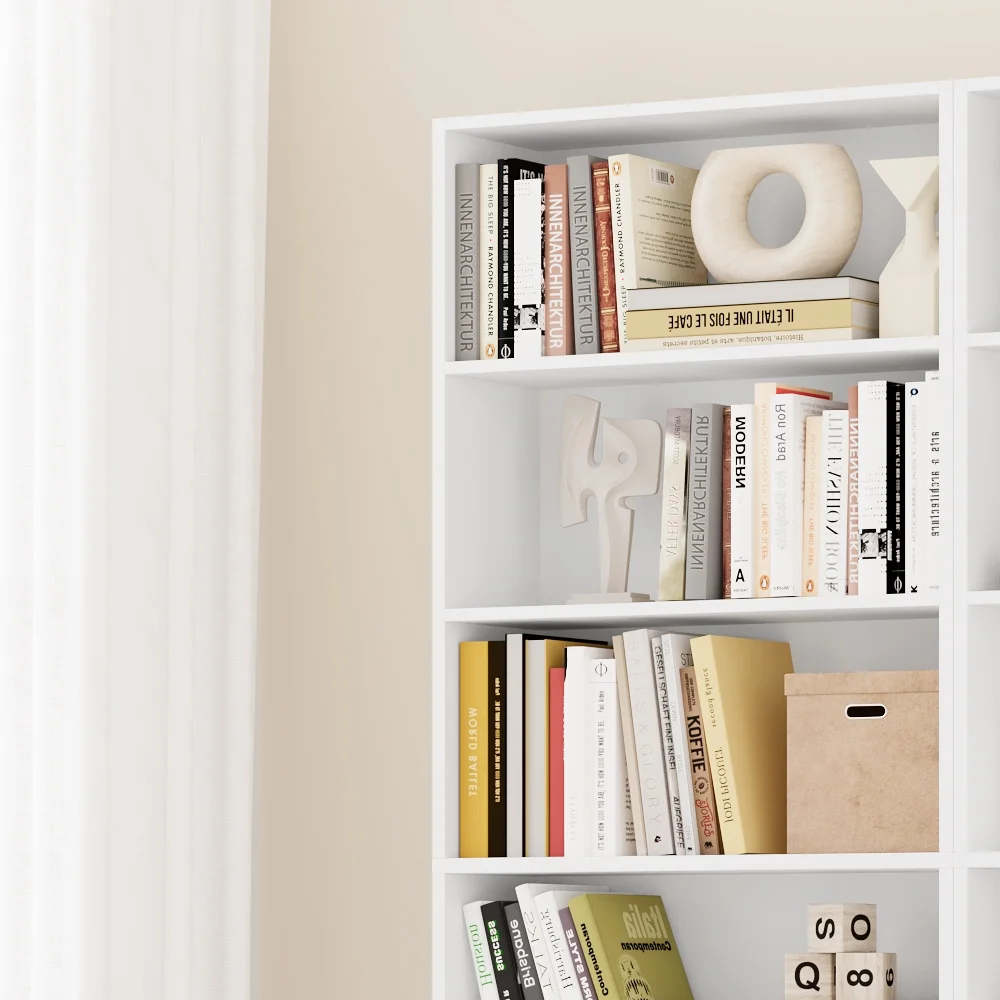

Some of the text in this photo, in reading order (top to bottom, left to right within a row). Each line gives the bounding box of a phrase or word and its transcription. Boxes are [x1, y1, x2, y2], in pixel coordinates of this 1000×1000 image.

[460, 193, 474, 352] INNENARCHITEKTUR
[549, 193, 564, 349] INNENARCHITEKTUR
[573, 186, 594, 346] INNENARCHITEKTUR
[668, 309, 794, 331] IL ÉTAIT UNE FOIS LE CAFÉ
[687, 715, 706, 773] KOFFIE
[696, 800, 714, 838] STORIES
[851, 914, 871, 941] O
[794, 962, 821, 992] Q
[846, 969, 874, 987] 8
